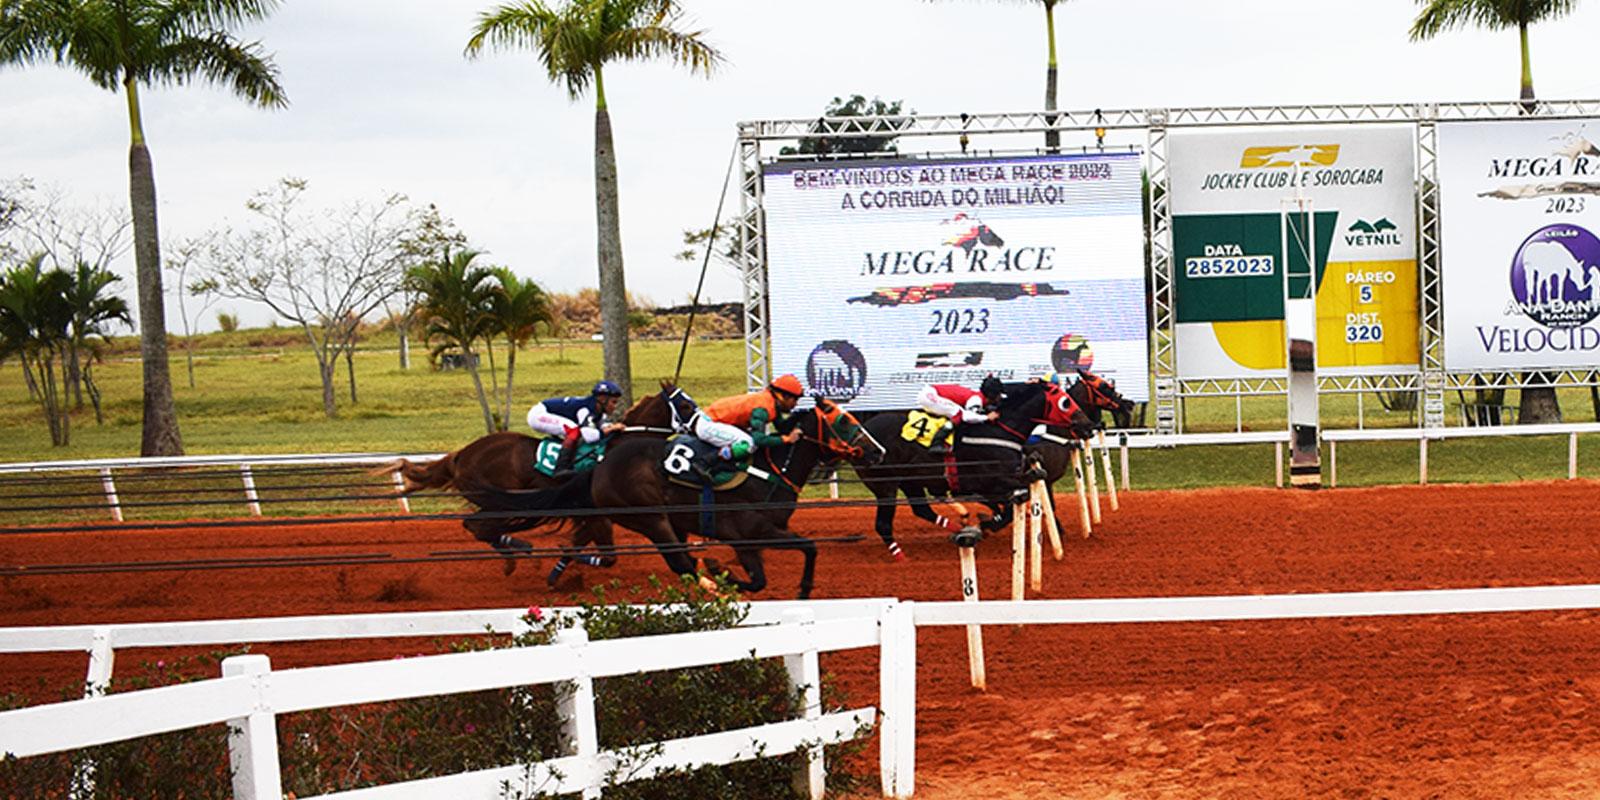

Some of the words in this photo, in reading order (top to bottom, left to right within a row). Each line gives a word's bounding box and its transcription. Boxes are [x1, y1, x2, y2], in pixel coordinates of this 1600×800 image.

[794, 169, 912, 187] BEM-VINDOS
[919, 168, 945, 183] AO
[950, 166, 1006, 182] MEGA
[1012, 165, 1063, 180] RACE
[1069, 163, 1112, 179] 2023
[1488, 157, 1563, 178] MEGA
[1202, 173, 1253, 190] JOCKEY
[1253, 172, 1287, 188] CLUB
[1313, 169, 1384, 186] SOROCABA
[842, 193, 855, 209] A
[860, 190, 947, 209] CORRIDA
[952, 188, 978, 206] DO
[985, 182, 1065, 206] MILHÃO!
[1545, 197, 1585, 213] 2023
[1345, 233, 1400, 246] VETNIL
[1204, 244, 1243, 256] DATA
[860, 250, 955, 276] MEGA
[968, 247, 1056, 272] RACE
[1186, 258, 1273, 276] 2852023
[1346, 269, 1395, 284] PÁREO
[1360, 286, 1372, 301] 5
[1503, 300, 1547, 316] ANA
[928, 308, 990, 335] 2023
[1346, 312, 1381, 324] DIST.
[1347, 325, 1382, 341] 320
[1476, 326, 1600, 353] VELOCID
[911, 417, 931, 437] 4
[664, 444, 695, 474] 6
[1031, 502, 1041, 517] 6
[963, 578, 974, 596] 8
